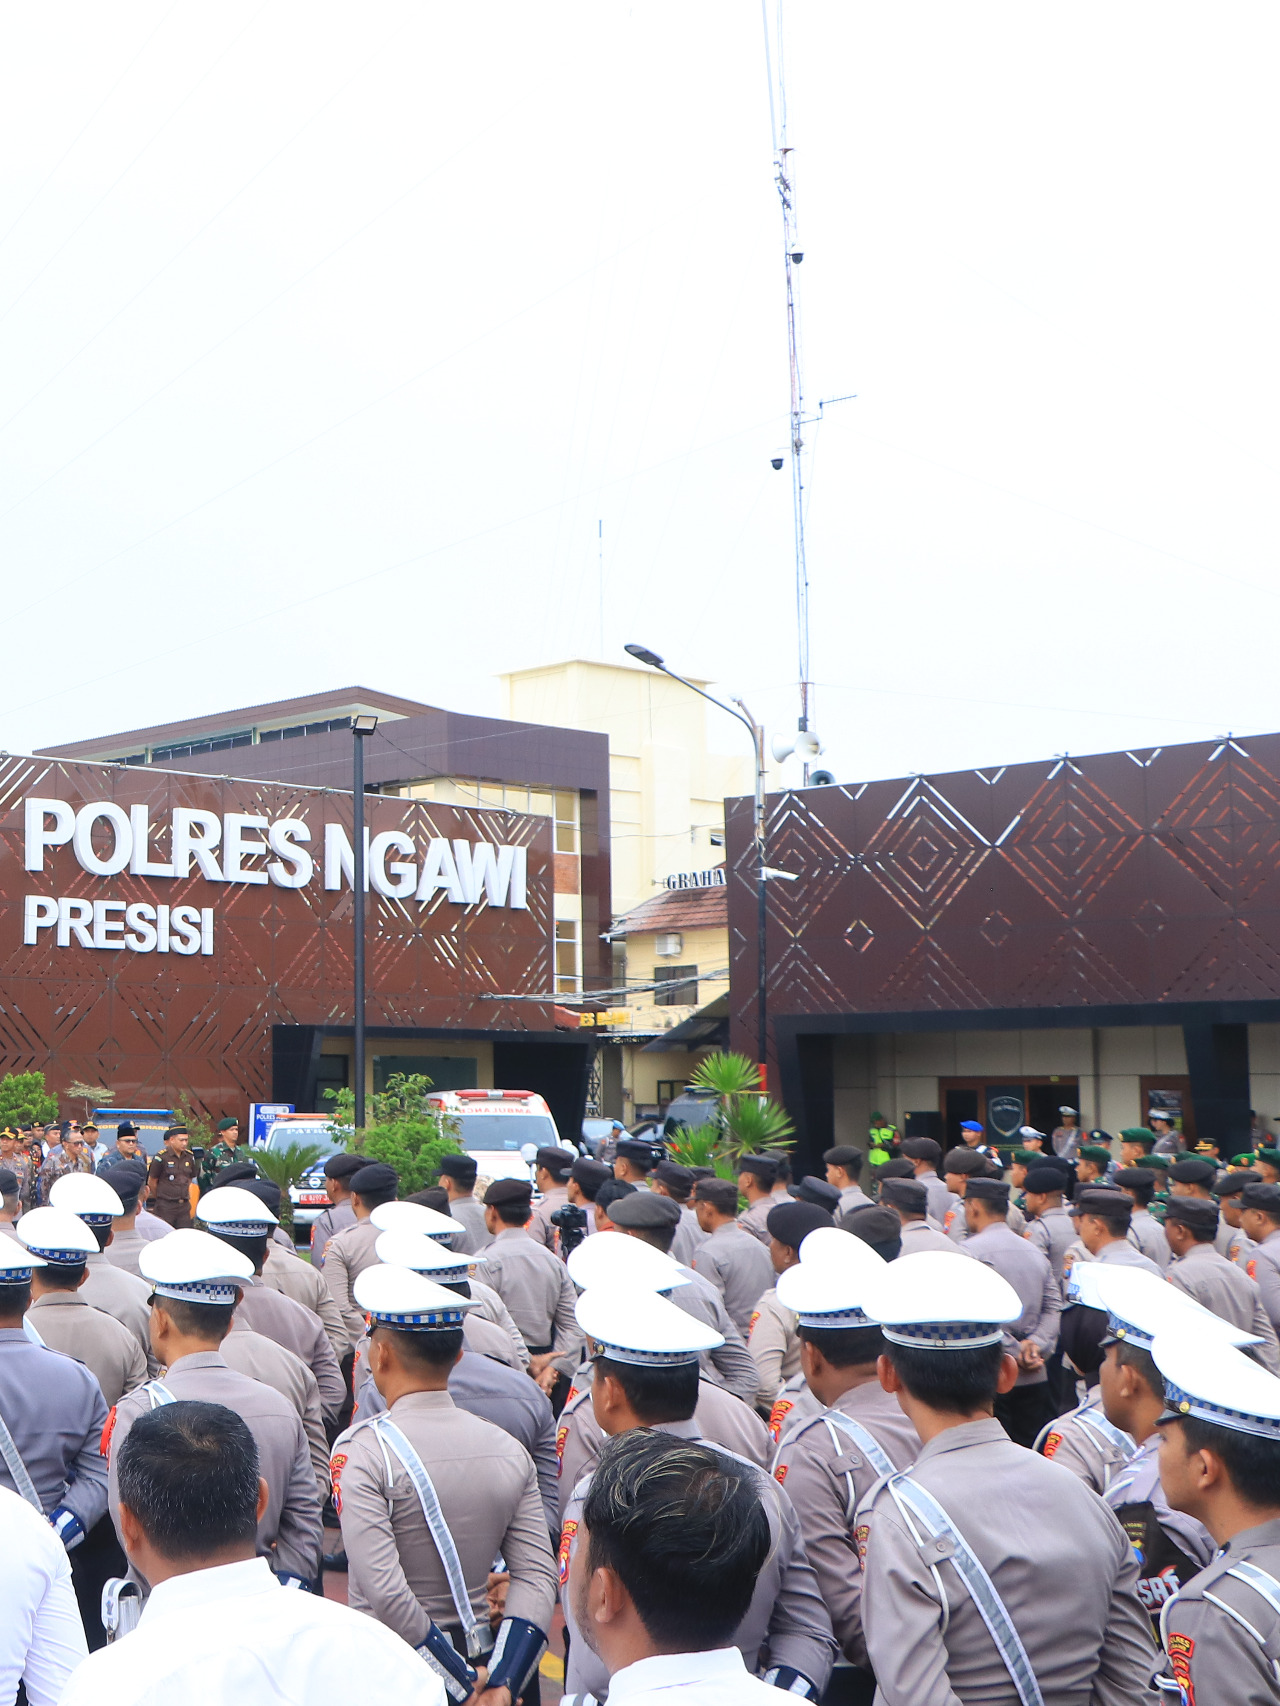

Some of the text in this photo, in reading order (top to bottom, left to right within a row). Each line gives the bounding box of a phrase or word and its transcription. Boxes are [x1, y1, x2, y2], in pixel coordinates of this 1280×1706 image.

[24, 797, 528, 910] POLRES NGAWI
[666, 867, 727, 890] GRAHA
[23, 893, 214, 956] PRESISI
